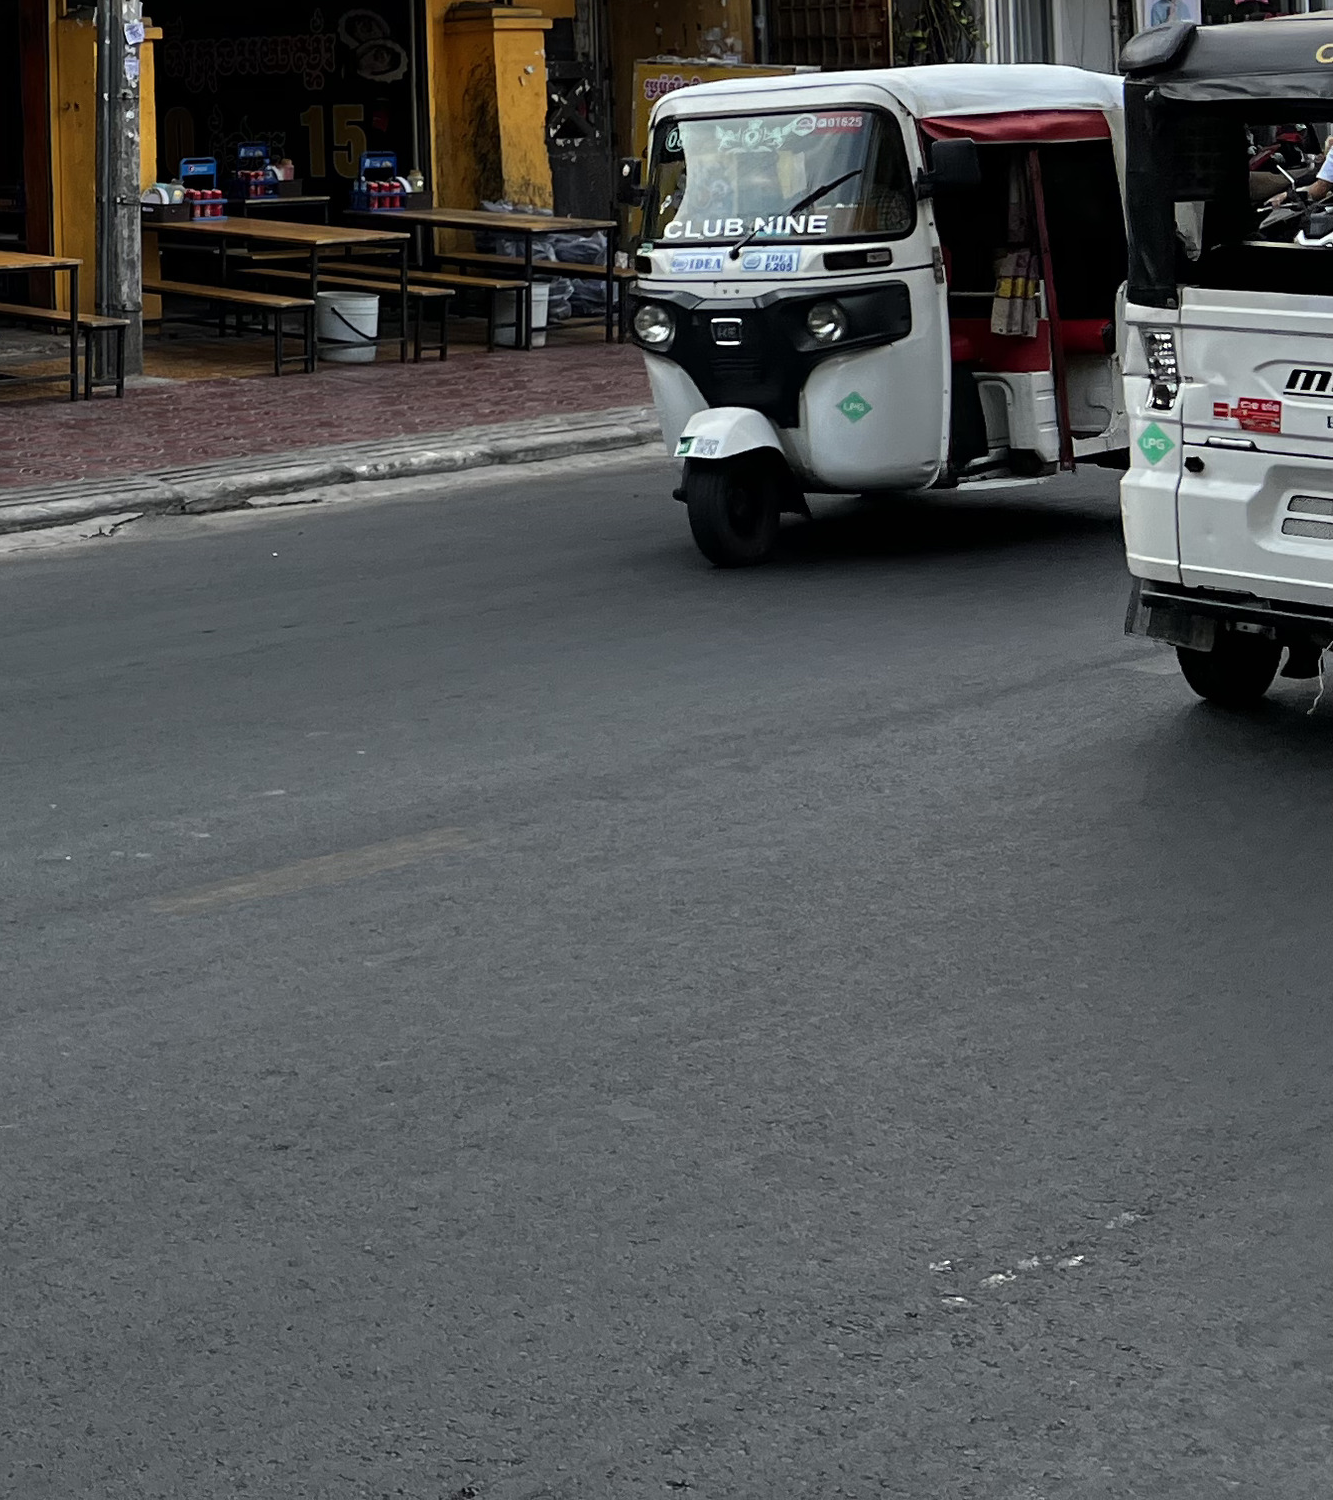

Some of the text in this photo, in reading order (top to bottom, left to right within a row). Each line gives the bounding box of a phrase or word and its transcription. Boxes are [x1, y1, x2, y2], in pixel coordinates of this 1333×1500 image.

[663, 214, 829, 240] CLUB NINE
[688, 258, 721, 271] IDEA
[1142, 437, 1166, 451] LPG
